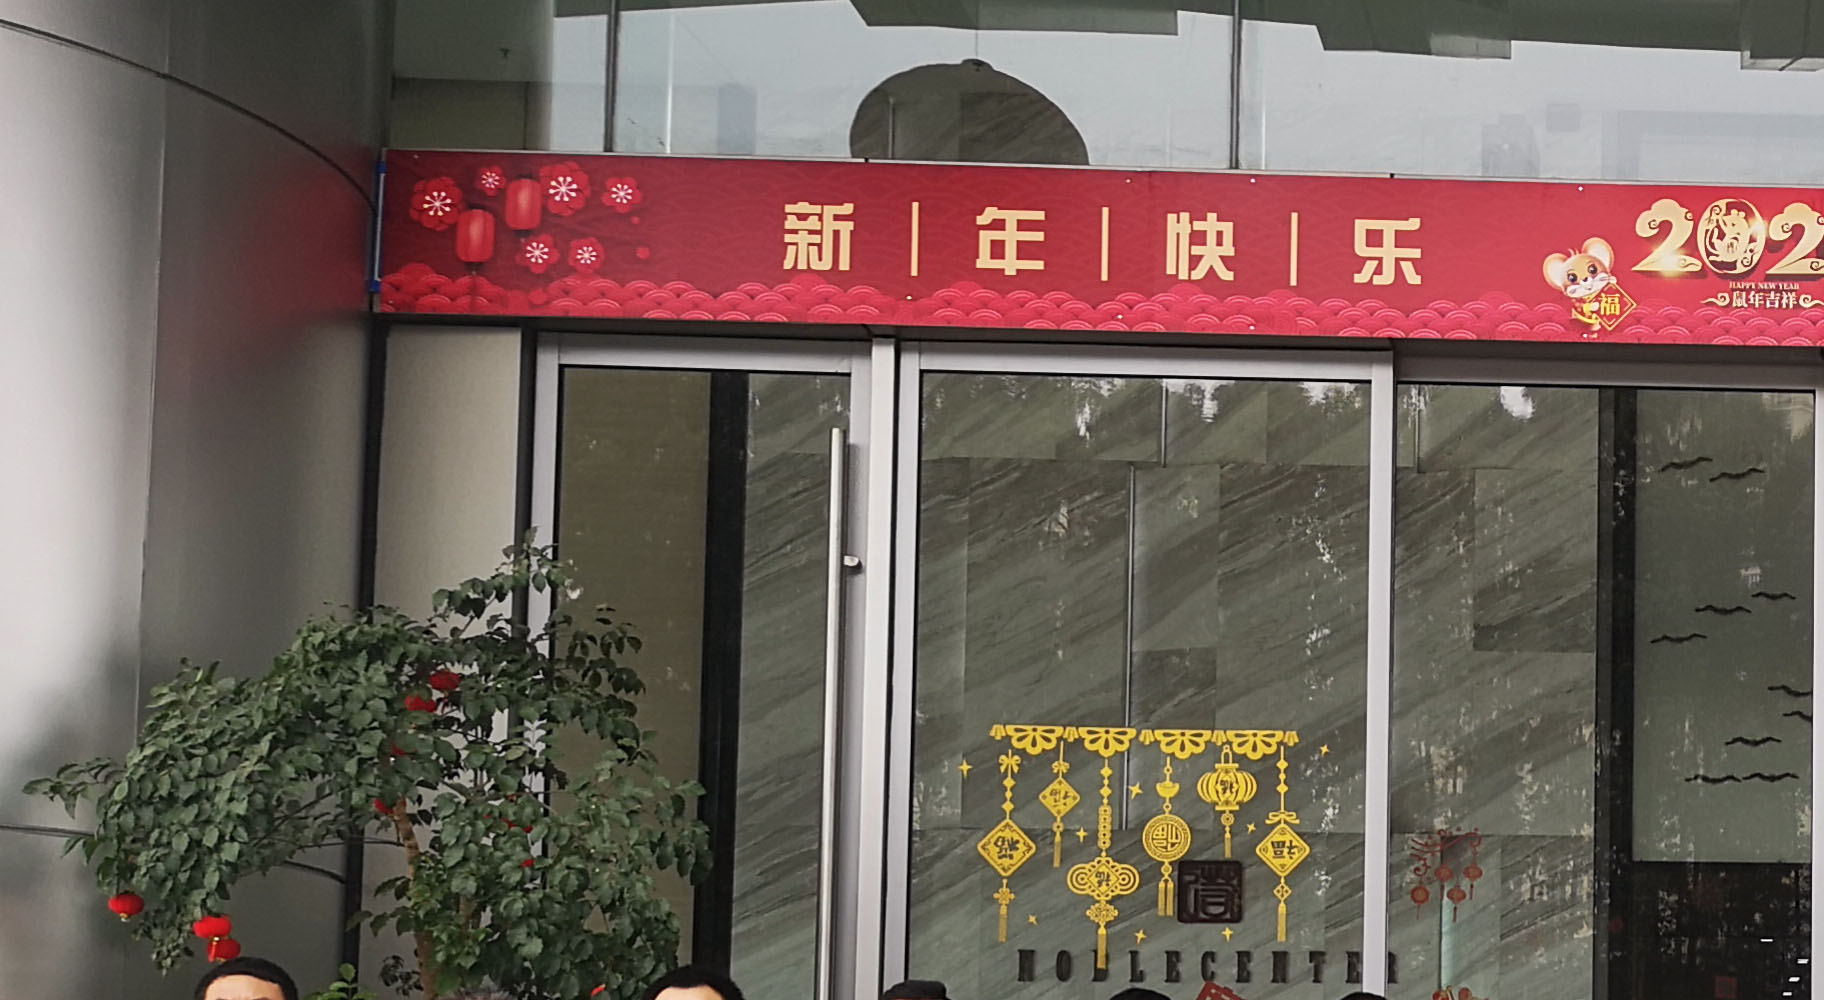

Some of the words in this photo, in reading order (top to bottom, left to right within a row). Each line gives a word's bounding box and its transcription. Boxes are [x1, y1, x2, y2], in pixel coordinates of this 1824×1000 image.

[1729, 281, 1755, 289] HAPPY
[1758, 282, 1776, 290] NEW
[1778, 282, 1800, 290] YEAR
[1597, 292, 1621, 316] 福
[1732, 290, 1797, 309] 鼠年吉祥
